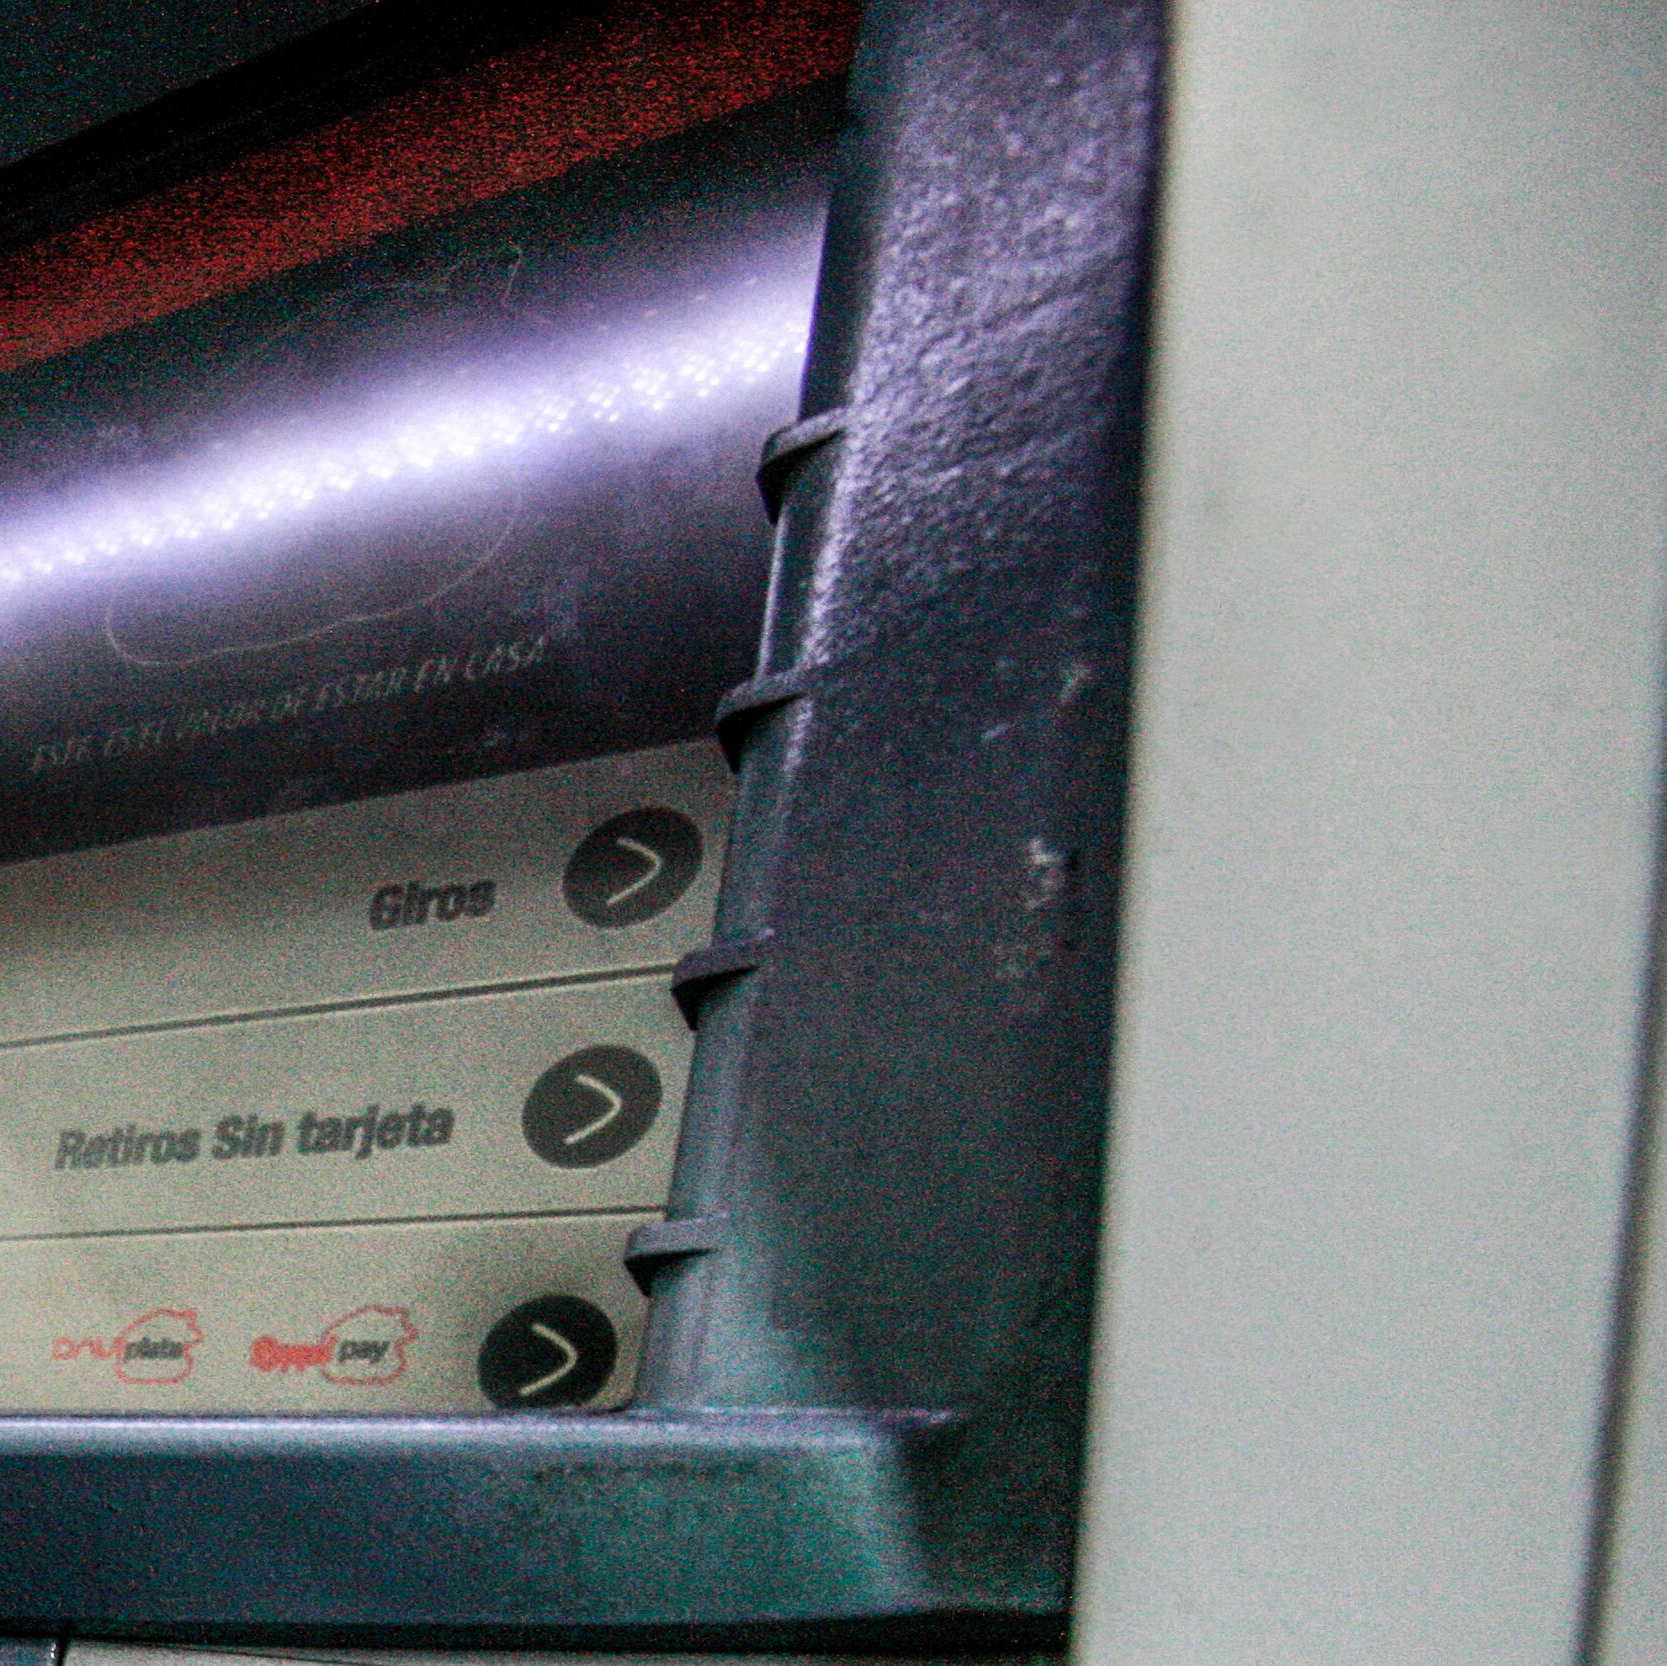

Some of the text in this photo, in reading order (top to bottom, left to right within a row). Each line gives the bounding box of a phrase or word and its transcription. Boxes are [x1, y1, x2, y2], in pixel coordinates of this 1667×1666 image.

[413, 653, 459, 694] EN
[464, 635, 548, 682] CASA
[368, 874, 497, 931] Giros
[54, 1102, 457, 1173] Retiros Sin tarjeta
